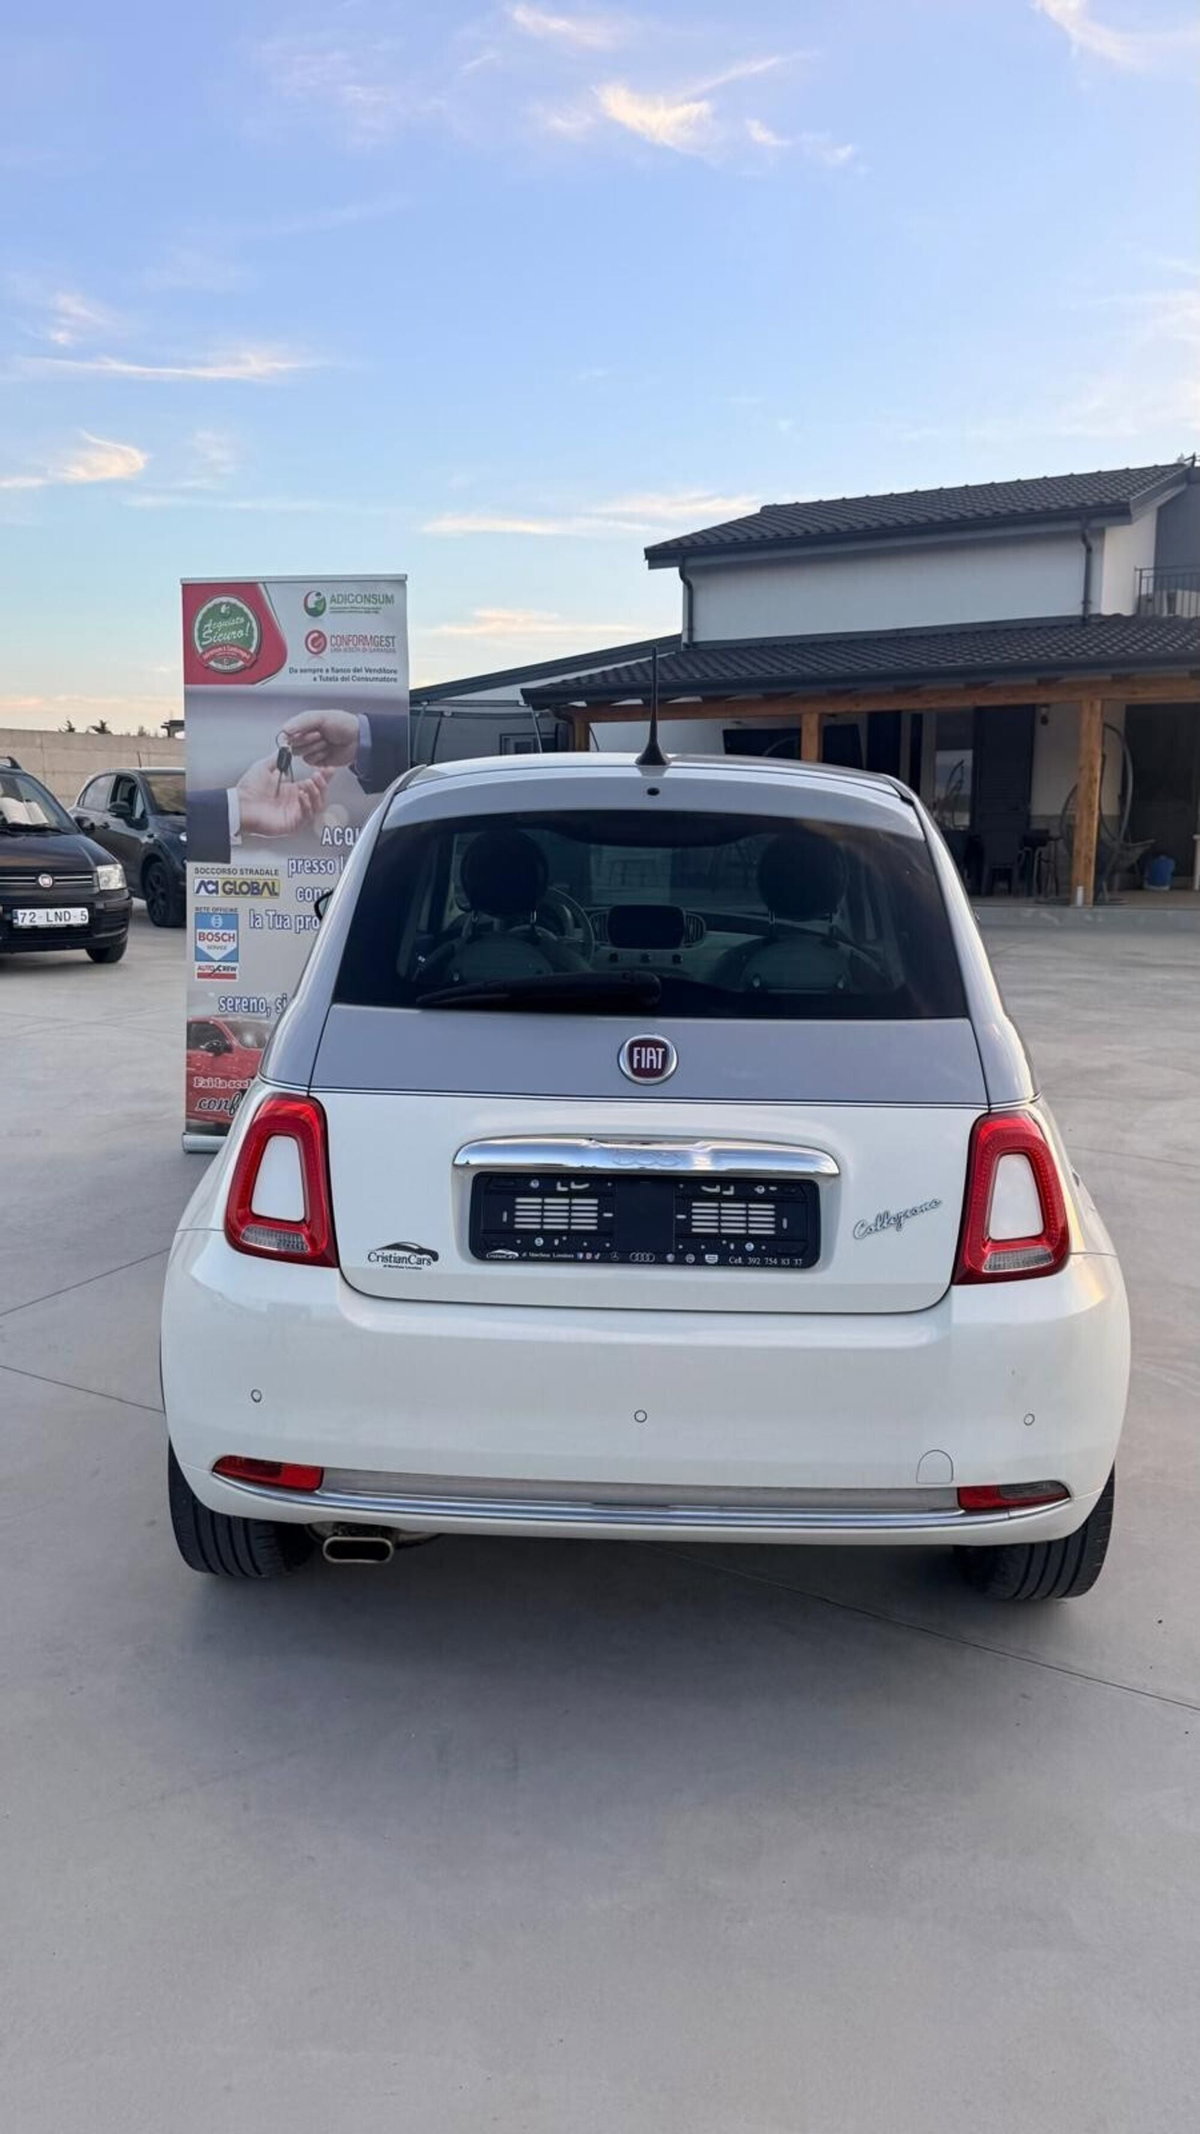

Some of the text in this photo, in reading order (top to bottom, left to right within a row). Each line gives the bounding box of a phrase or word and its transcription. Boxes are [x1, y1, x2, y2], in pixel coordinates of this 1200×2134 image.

[330, 593, 395, 605] ADICONSUM
[201, 621, 251, 646] Sicuro!
[330, 635, 396, 648] CONFORMGEST
[194, 867, 280, 877] SOCCORSO STRADALE
[287, 857, 336, 878] presso
[195, 880, 279, 897] ACI GLOBAL
[249, 909, 263, 929] la
[265, 909, 291, 929] Tua
[198, 931, 236, 943] BOSCH
[218, 995, 271, 1017] sereno,
[632, 1046, 666, 1070] FIAT
[367, 1251, 432, 1266] CristianCars
